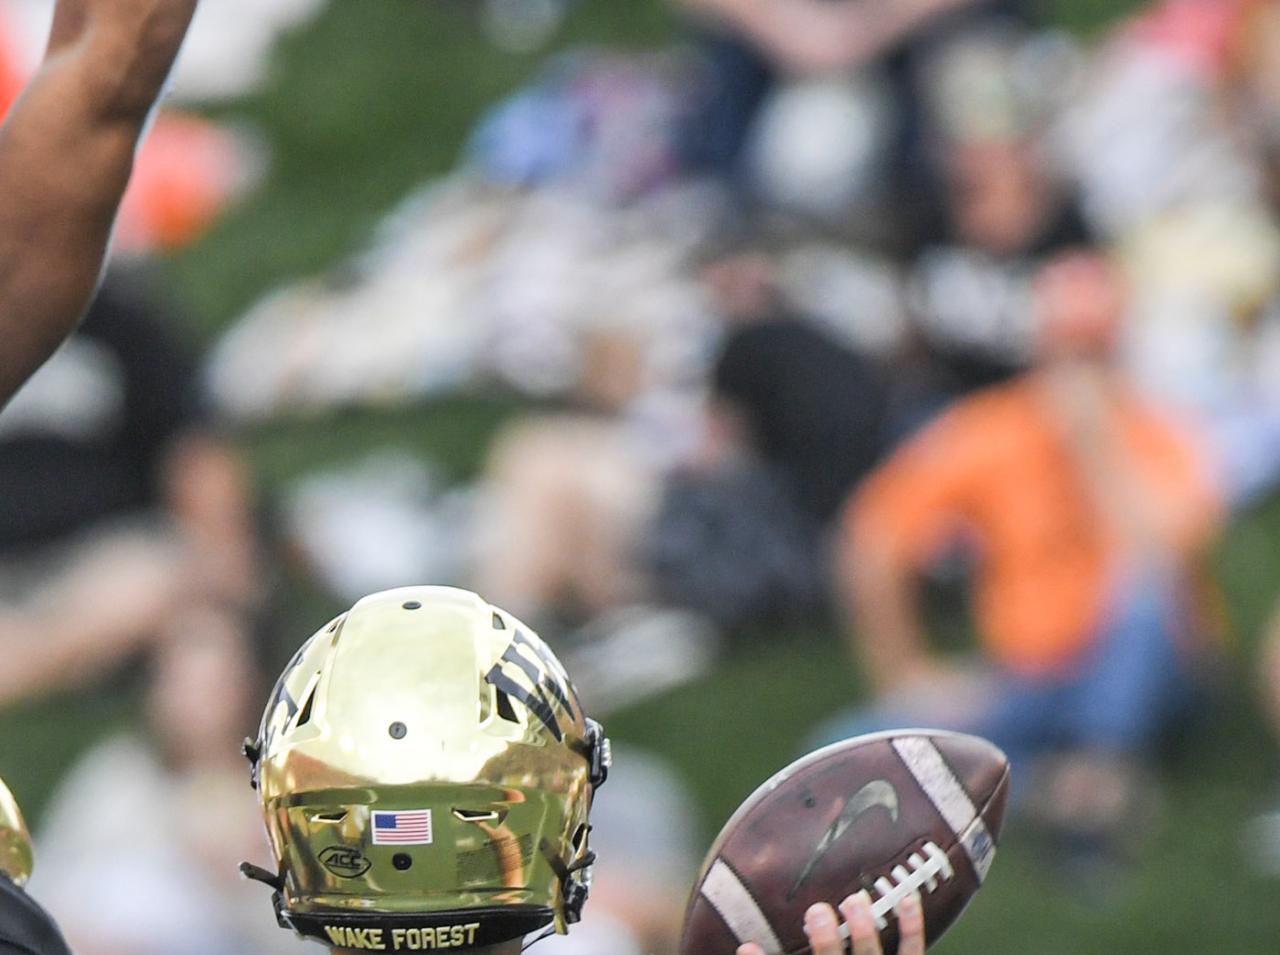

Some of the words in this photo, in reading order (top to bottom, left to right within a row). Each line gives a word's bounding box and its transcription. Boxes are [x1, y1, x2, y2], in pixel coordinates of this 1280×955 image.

[325, 852, 363, 867] ACC
[324, 924, 386, 950] WAKE
[391, 922, 481, 950] FOREST
